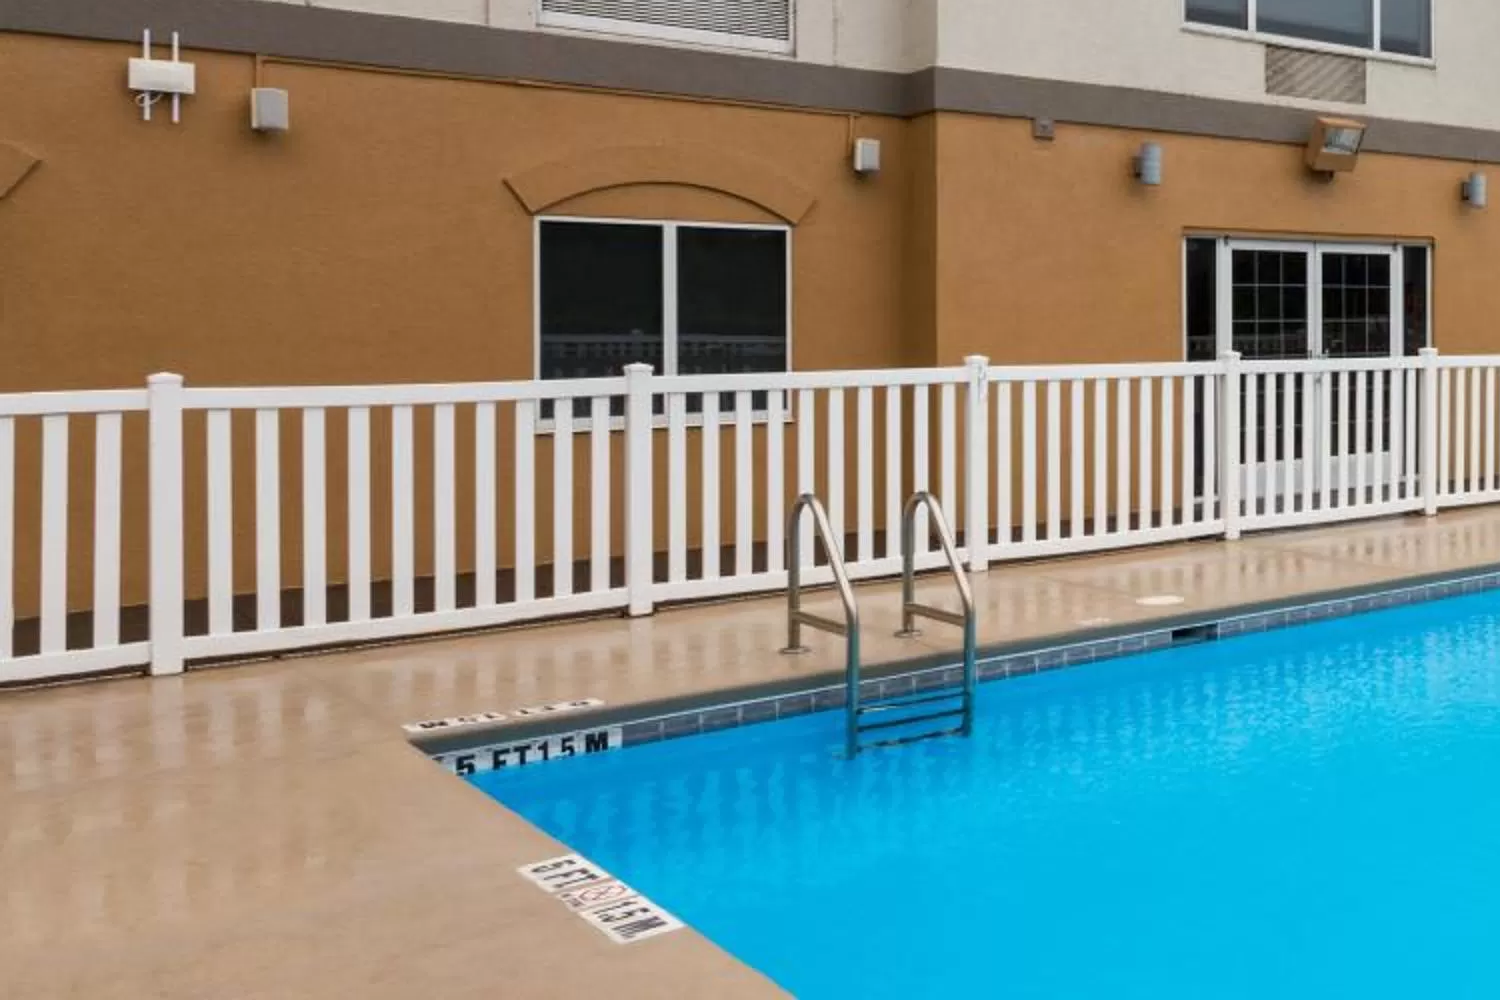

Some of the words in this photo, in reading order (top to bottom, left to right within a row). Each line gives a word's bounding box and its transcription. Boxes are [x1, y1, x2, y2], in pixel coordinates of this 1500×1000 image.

[455, 754, 476, 776] 5
[492, 744, 531, 770] FT
[585, 731, 609, 753] M
